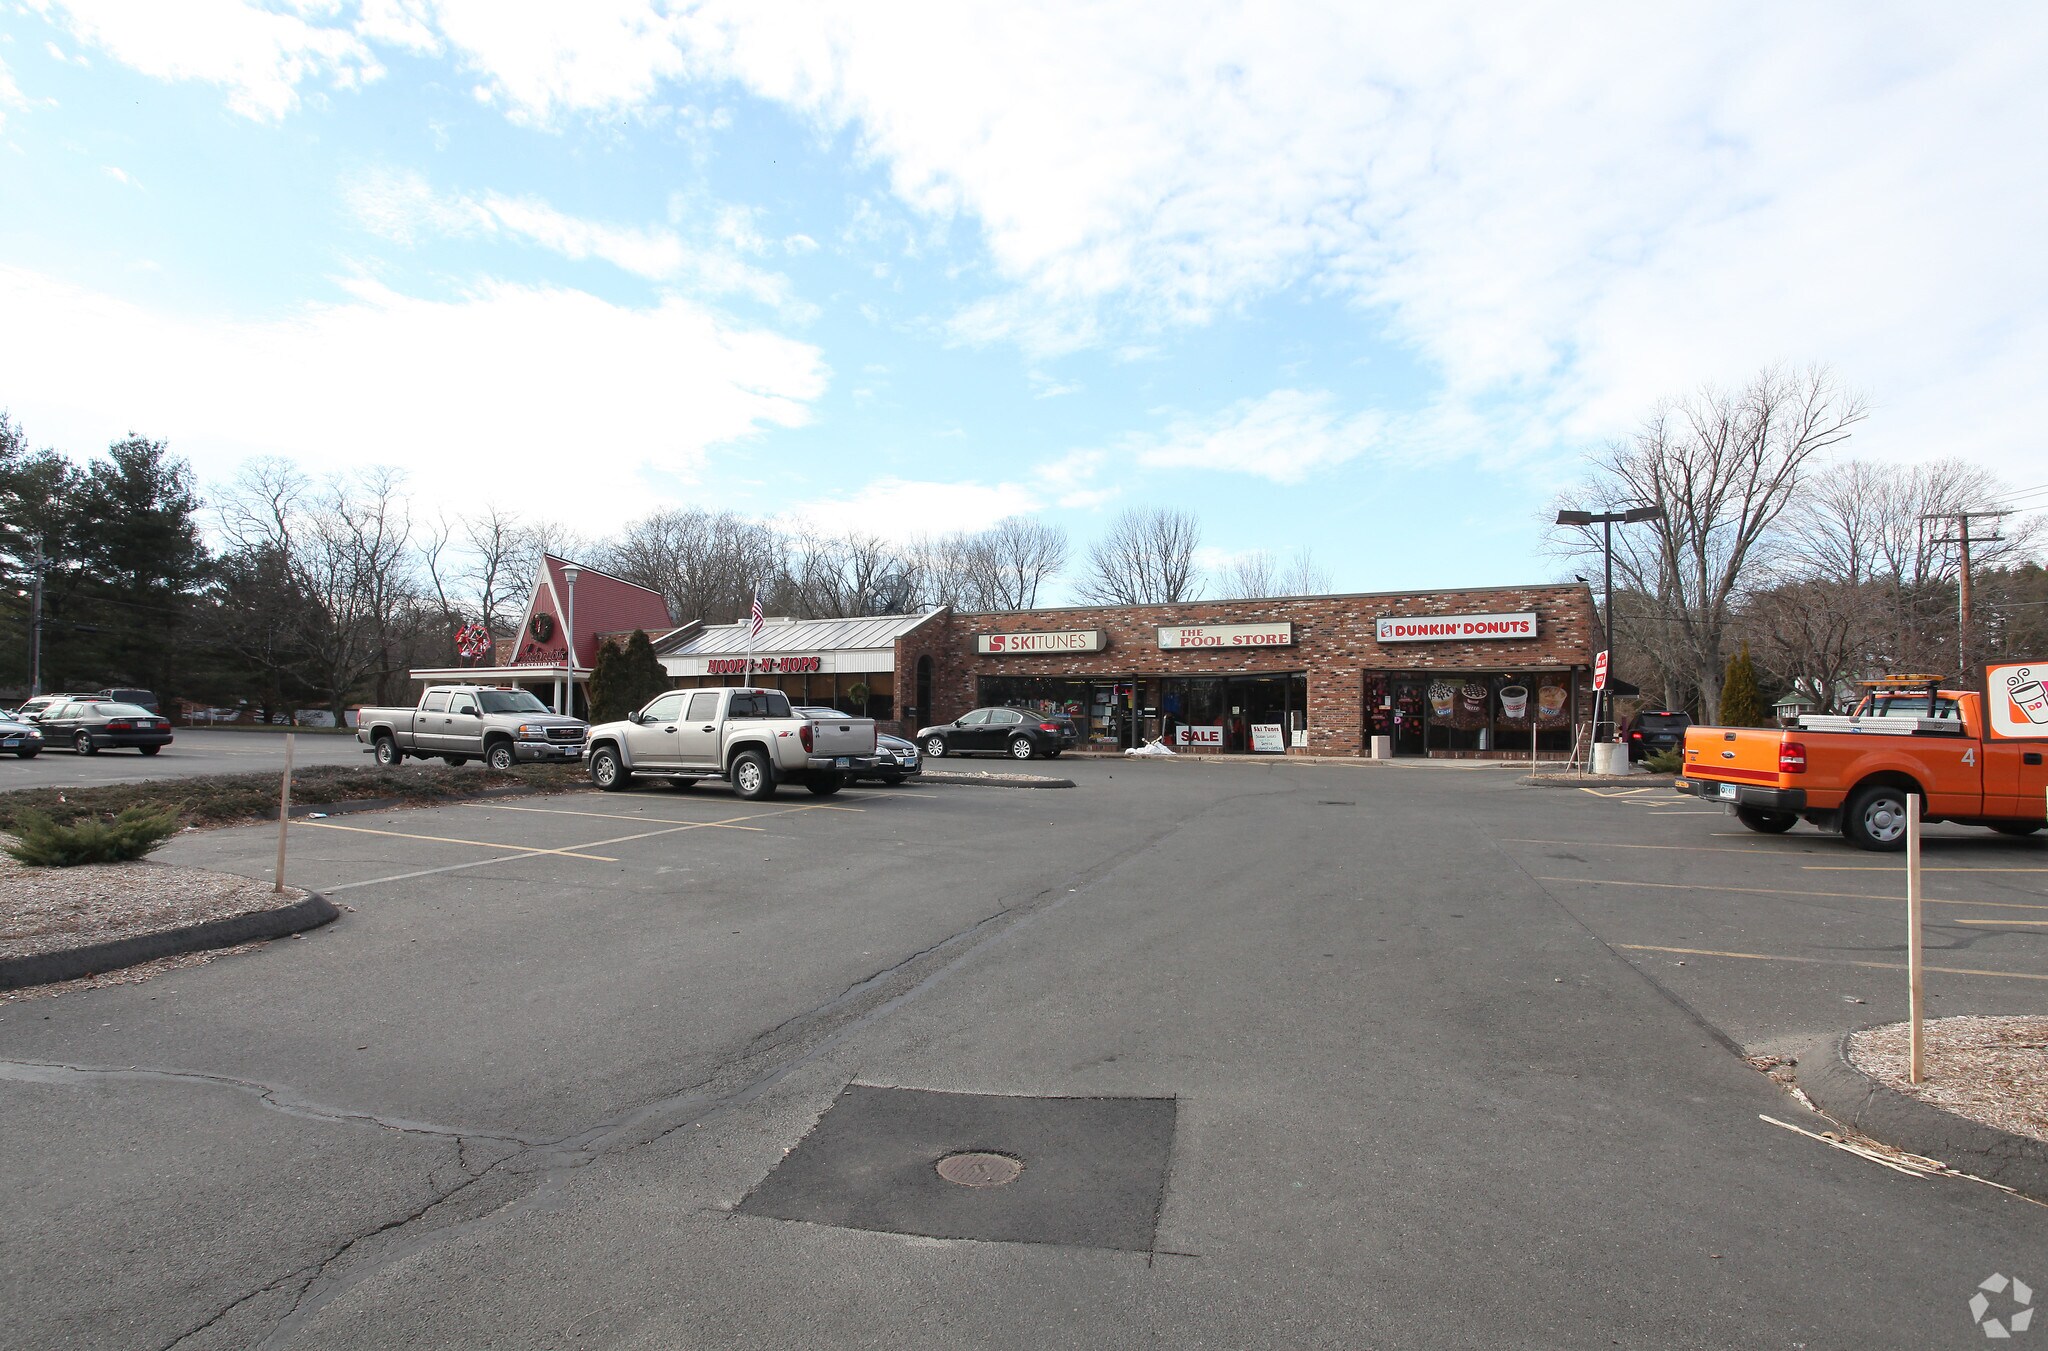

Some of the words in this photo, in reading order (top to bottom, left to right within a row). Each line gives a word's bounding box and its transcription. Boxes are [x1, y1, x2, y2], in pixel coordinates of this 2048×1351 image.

[1180, 629, 1203, 637] THE
[1395, 623, 1461, 637] DUNKIN'
[1463, 621, 1529, 634] DONUTS
[1180, 636, 1225, 647] POOL
[1232, 633, 1289, 645] STORE
[707, 656, 821, 673] HOOPS-N-HOPS
[2027, 701, 2043, 711] DD
[1180, 730, 1219, 742] SALE
[1961, 748, 1976, 767] 4
